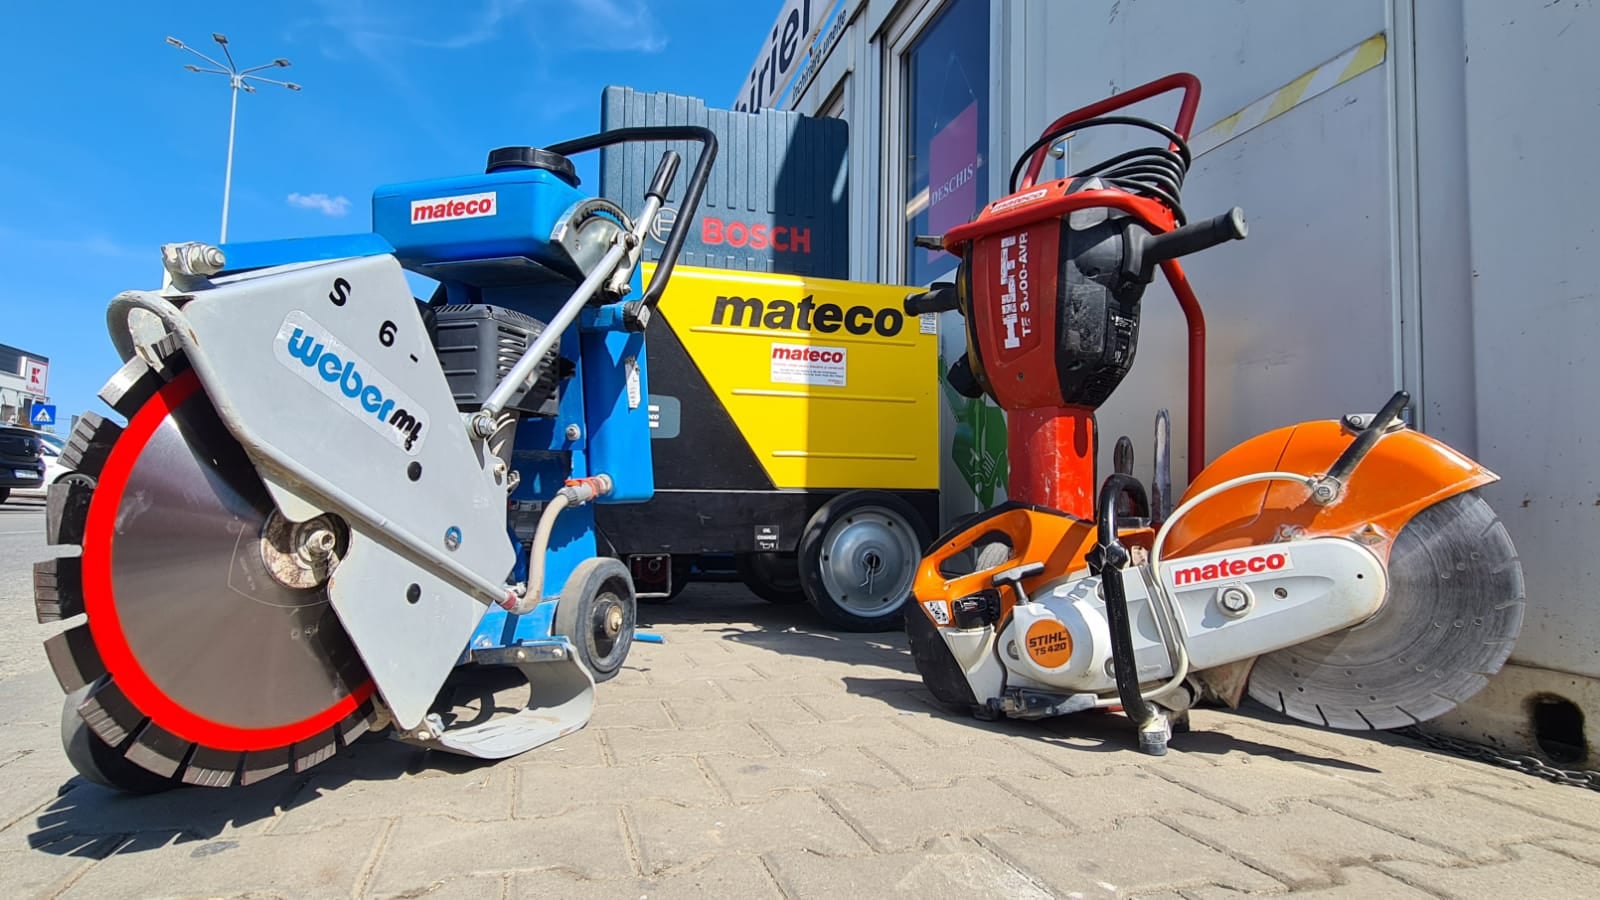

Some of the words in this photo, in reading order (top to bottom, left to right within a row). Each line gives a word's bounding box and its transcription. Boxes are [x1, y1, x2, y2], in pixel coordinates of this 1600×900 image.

[931, 163, 974, 208] DESCHIS
[413, 200, 492, 221] mateco
[702, 216, 811, 254] BOSCH
[1001, 236, 1020, 349] HILTI
[329, 277, 352, 307] S
[379, 320, 398, 347] 6
[711, 294, 904, 337] mateco
[772, 347, 844, 363] mateco
[288, 327, 396, 422] weber
[1175, 553, 1286, 585] mateco
[1029, 631, 1067, 648] STIHL
[1034, 646, 1046, 656] TS
[1047, 642, 1067, 653] 420
